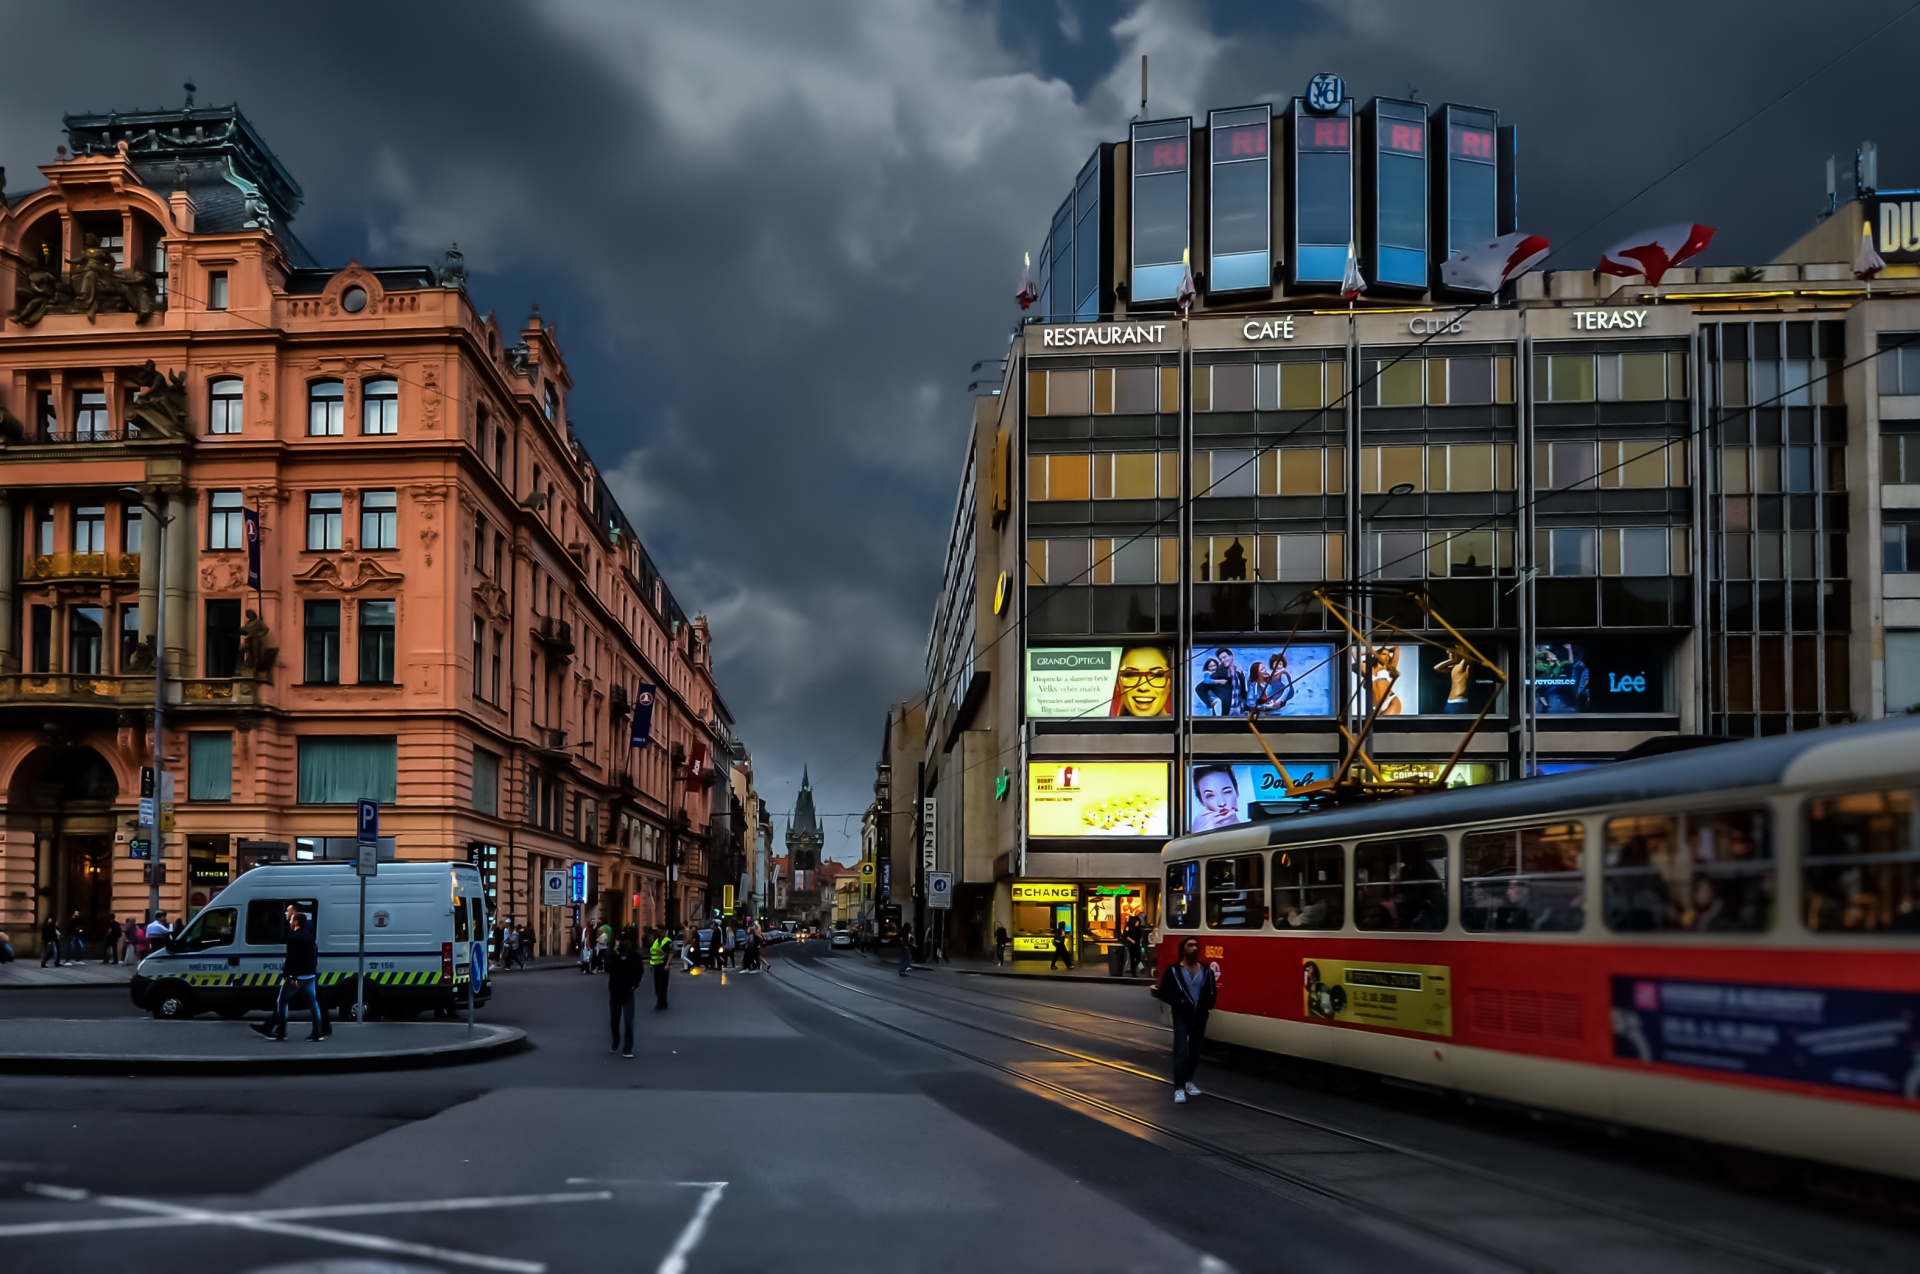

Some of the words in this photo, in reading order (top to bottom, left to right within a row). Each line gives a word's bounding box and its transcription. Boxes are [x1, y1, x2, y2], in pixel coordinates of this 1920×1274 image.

[1880, 201, 1920, 252] DU
[1243, 315, 1294, 340] CAFÉ
[1409, 315, 1462, 334] CLUB
[1573, 310, 1647, 330] TERASY
[1043, 325, 1165, 346] RESTAURANT
[1608, 672, 1646, 693] Lee
[362, 804, 375, 830] P
[1024, 888, 1077, 897] CHANGE
